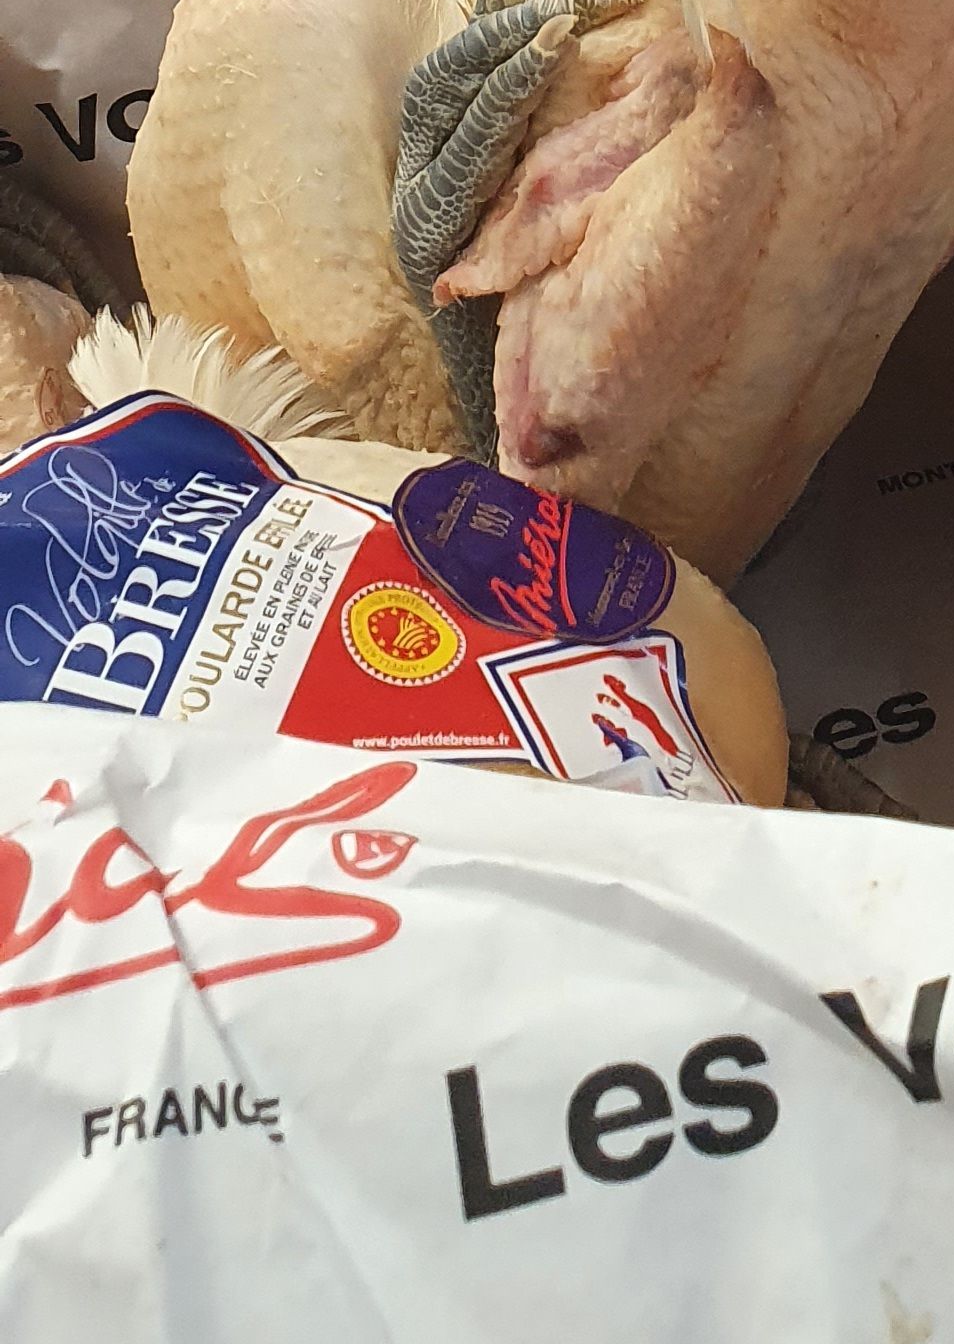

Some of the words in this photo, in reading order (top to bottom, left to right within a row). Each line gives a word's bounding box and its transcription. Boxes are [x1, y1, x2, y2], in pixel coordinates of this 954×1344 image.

[42, 471, 260, 717] BRESSE
[174, 547, 274, 722] OULARDE
[234, 627, 271, 683] ÉLEVÉE
[266, 602, 283, 629] EN
[254, 654, 277, 690] AUX
[301, 561, 318, 586] DE
[297, 610, 315, 631] ET
[306, 588, 323, 610] AU
[315, 562, 338, 590] LAIT
[352, 730, 510, 750] www.pouletdebresse.fr
[812, 690, 938, 760] es
[444, 1033, 780, 1223] Les
